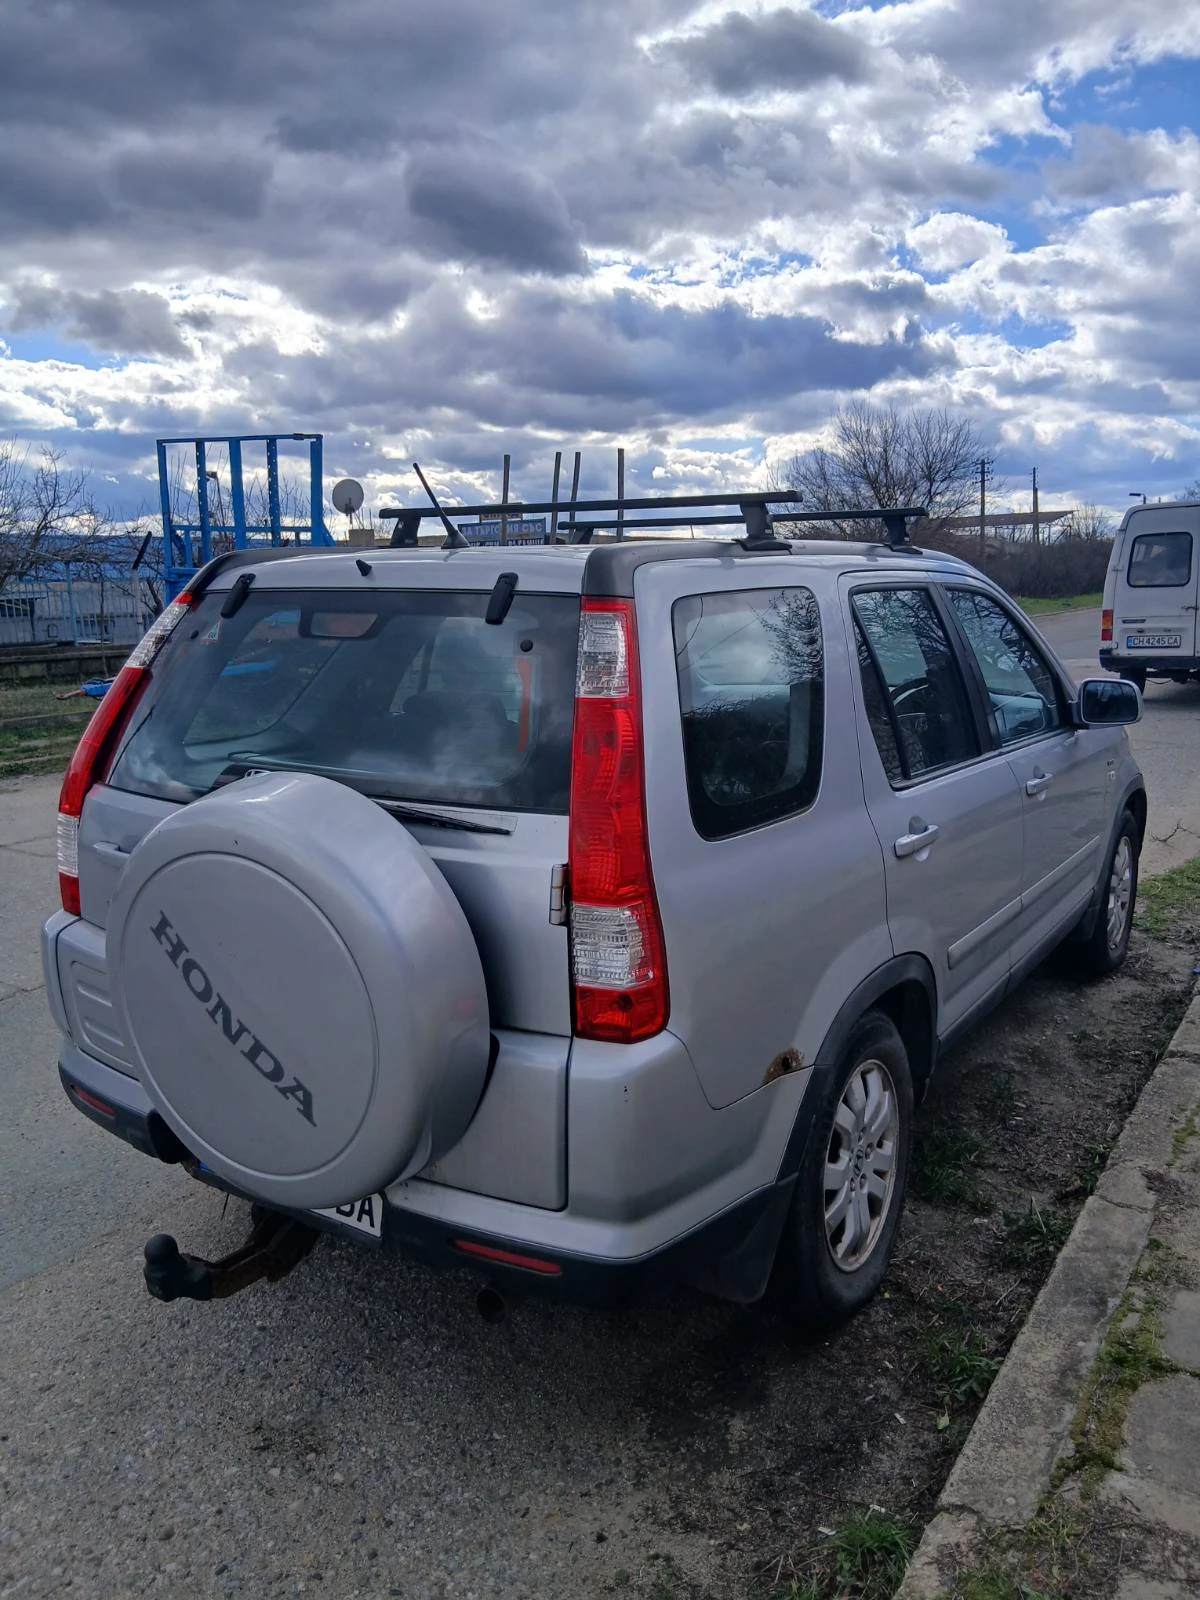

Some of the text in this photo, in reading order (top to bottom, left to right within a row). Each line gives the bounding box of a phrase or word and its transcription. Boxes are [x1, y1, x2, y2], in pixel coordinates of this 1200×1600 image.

[1145, 636, 1166, 645] 4245
[1167, 636, 1178, 645] CA
[150, 909, 317, 1127] HONDA
